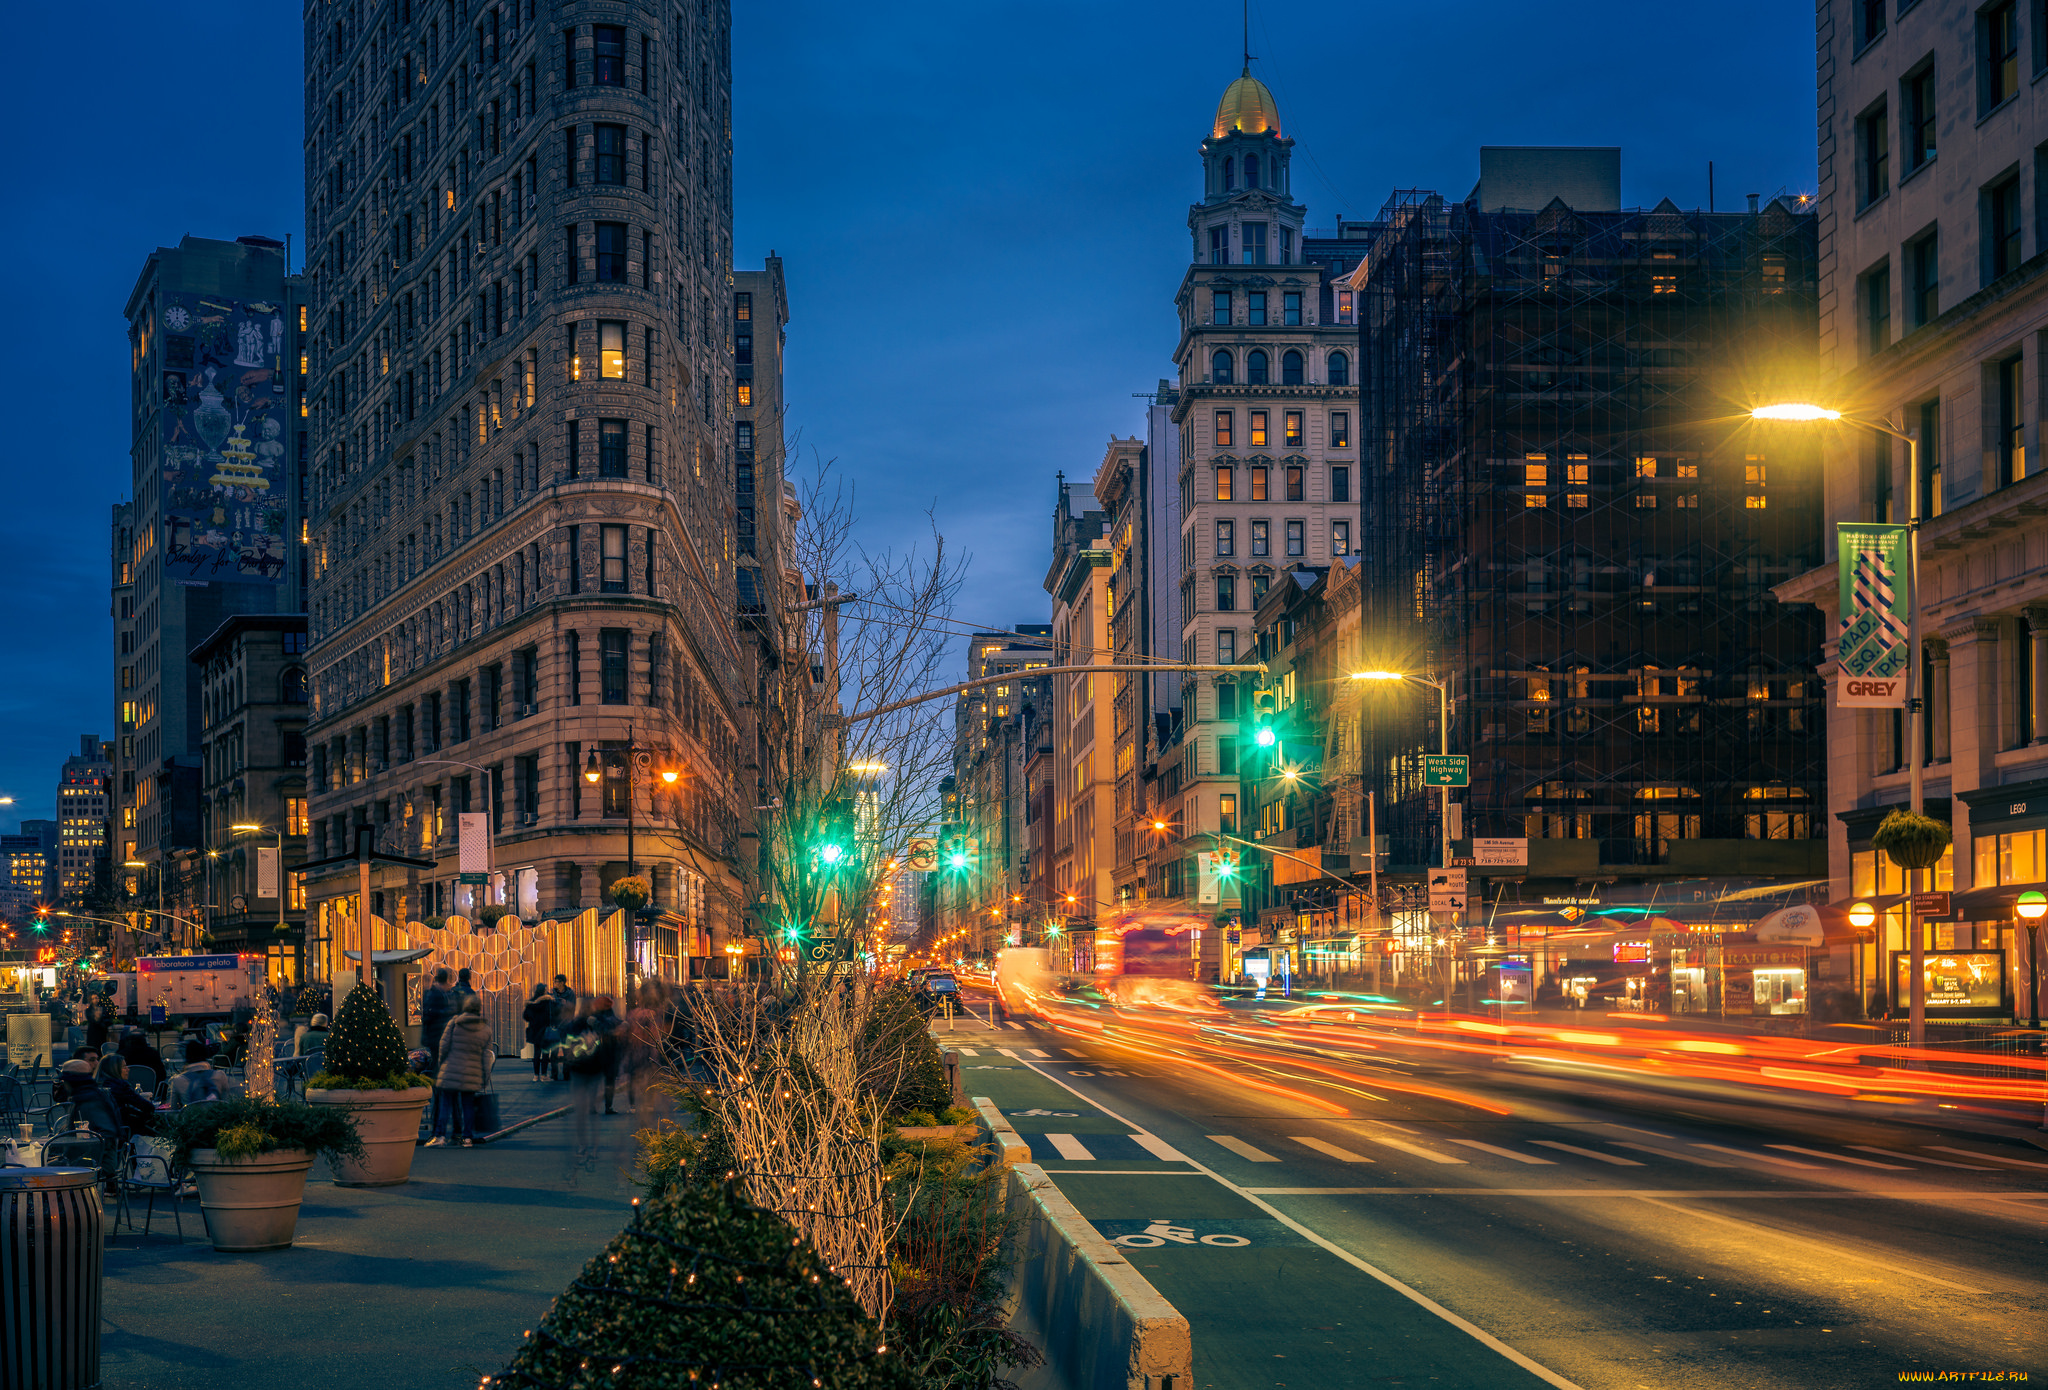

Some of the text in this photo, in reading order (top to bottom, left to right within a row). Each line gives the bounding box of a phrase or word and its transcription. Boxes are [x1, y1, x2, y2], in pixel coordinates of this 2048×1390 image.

[211, 548, 234, 575] for
[1839, 620, 1876, 656] MAD.
[1851, 649, 1880, 673] SQ.
[1846, 681, 1897, 697] GREY
[1428, 758, 1466, 766] West Side
[1430, 766, 1463, 775] Highway
[2009, 803, 2027, 815] LEGO
[1543, 897, 1562, 905] Bank
[154, 959, 195, 968] laboratorio
[207, 957, 231, 968] gelato
